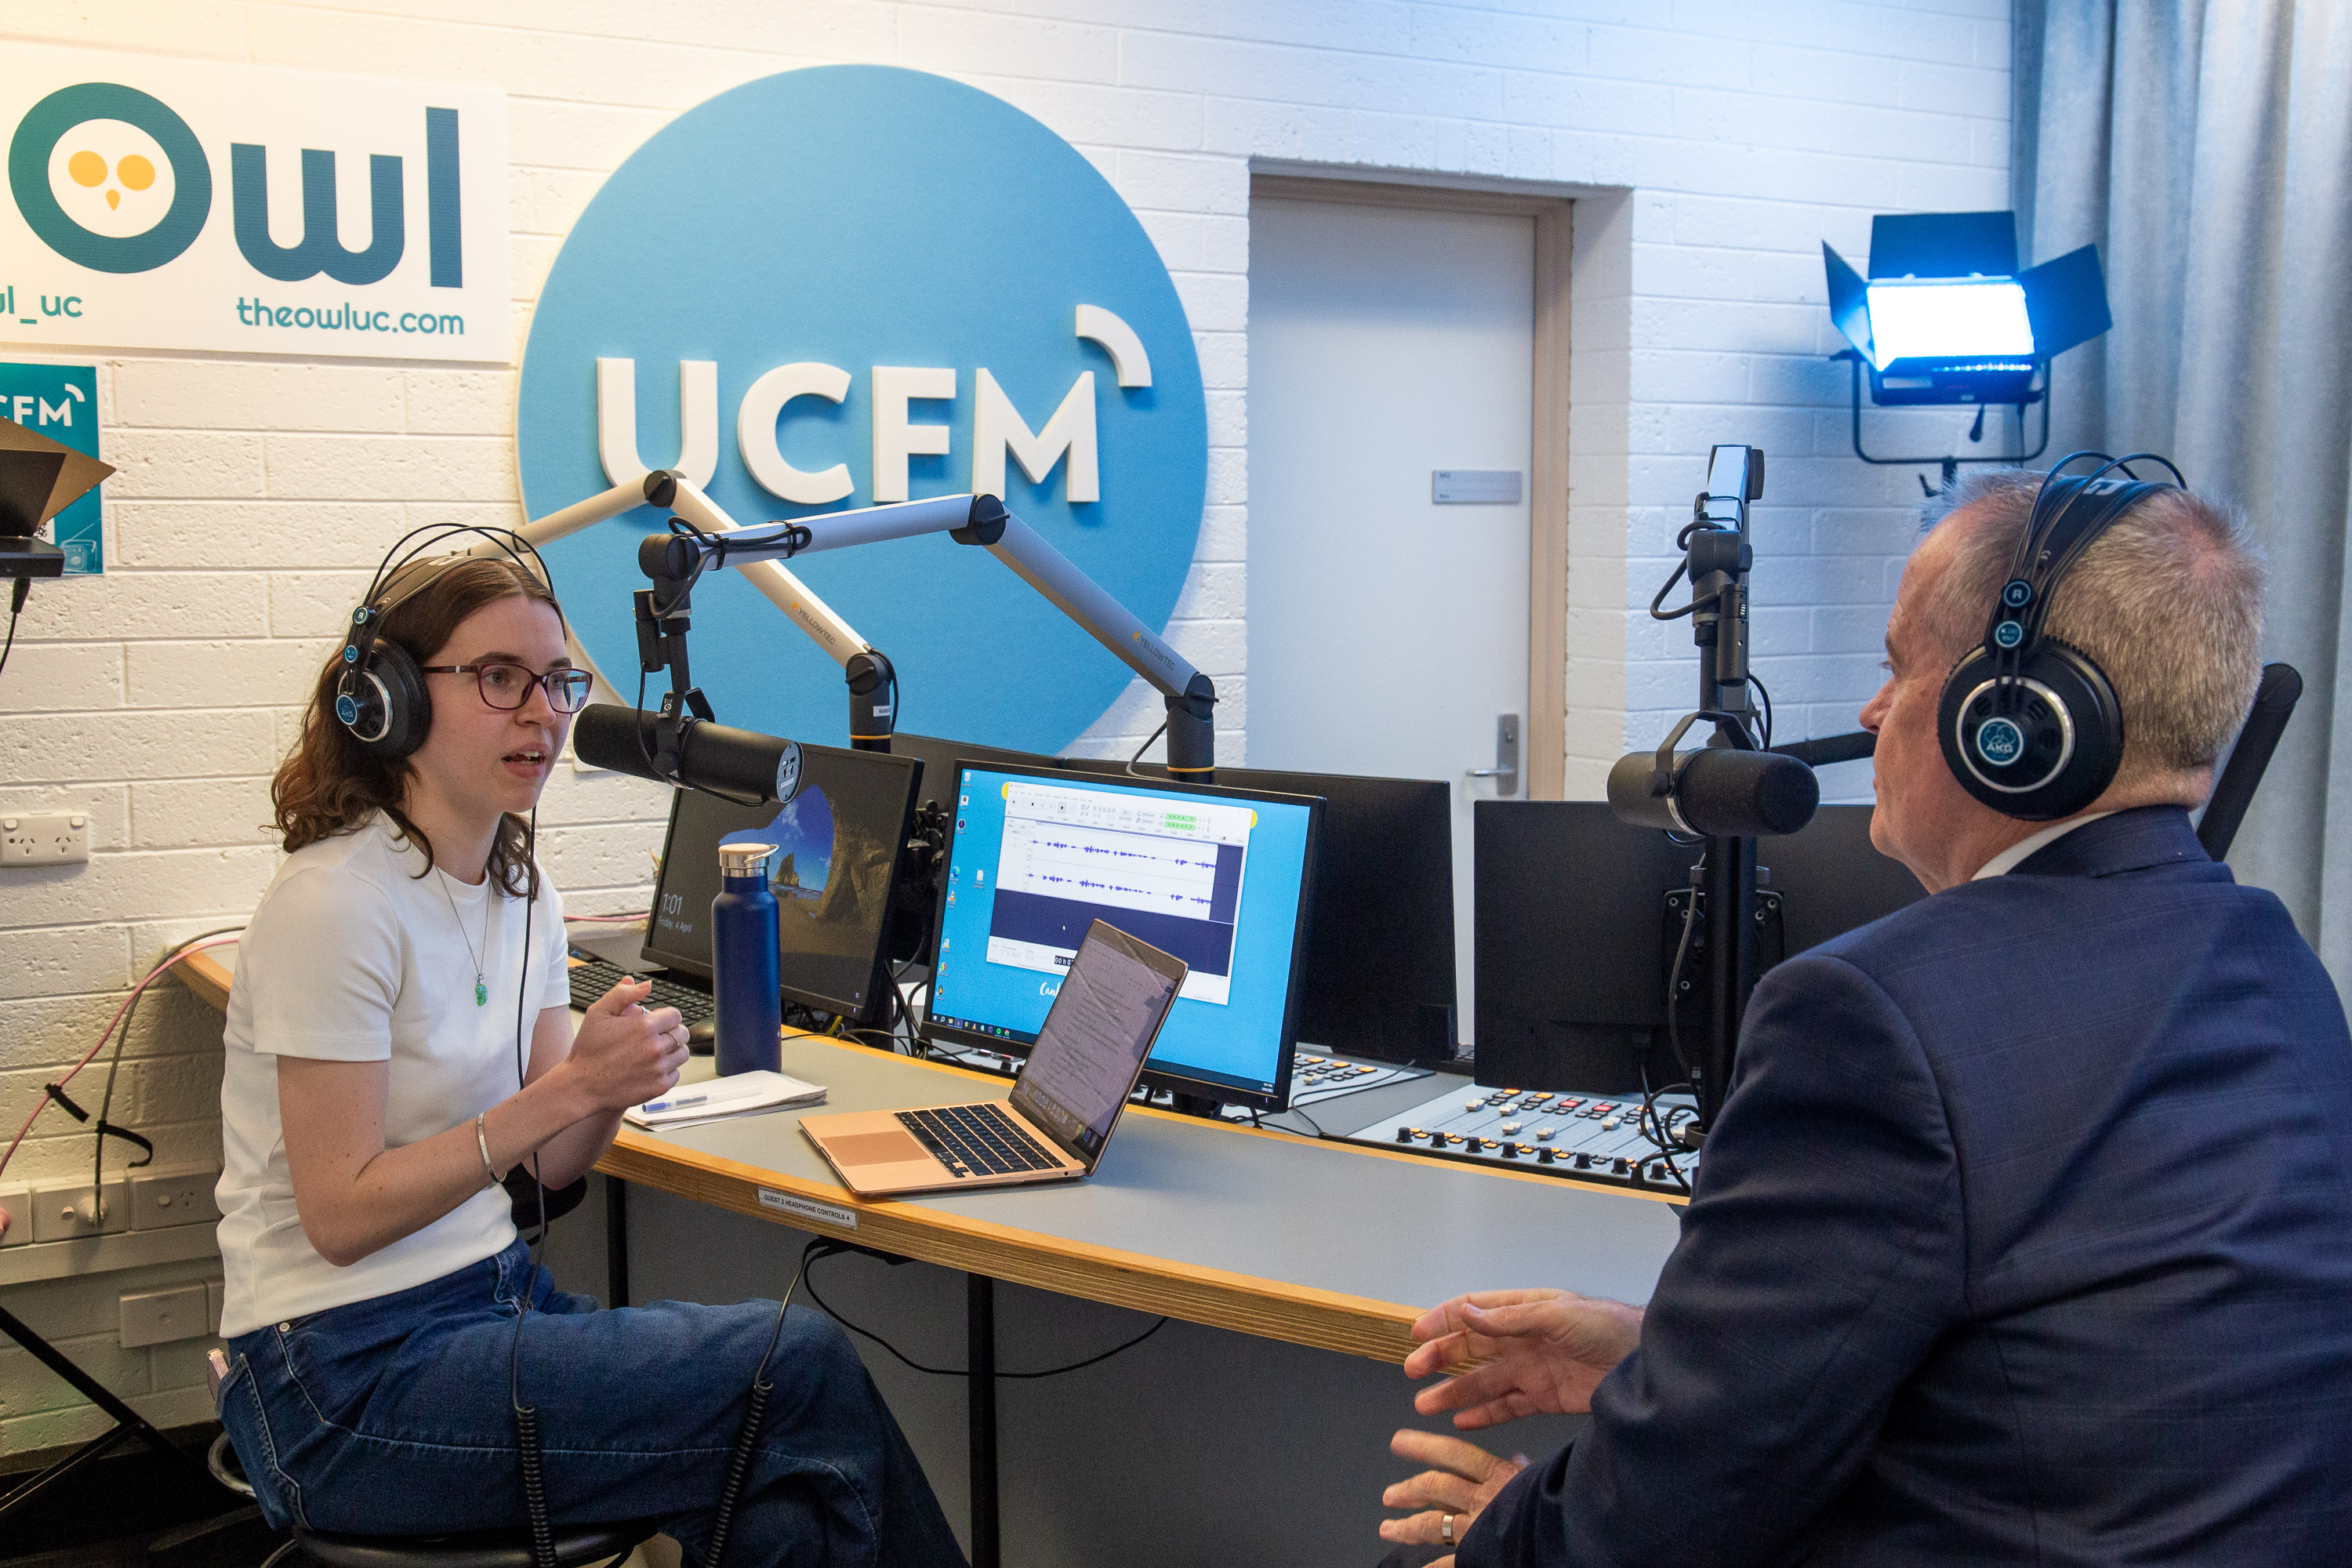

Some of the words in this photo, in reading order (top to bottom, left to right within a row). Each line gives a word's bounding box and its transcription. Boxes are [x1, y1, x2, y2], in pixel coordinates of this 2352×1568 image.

[8, 82, 463, 289] Owl
[0, 285, 83, 325] l_uc
[236, 297, 465, 335] theowluc.com
[597, 358, 1100, 504] UCFM
[2013, 589, 2022, 599] R
[798, 608, 837, 645] YELLOWTEC
[1140, 636, 1176, 671] YELLOWTEC
[1986, 742, 2013, 753] AKG
[662, 893, 683, 916] 1:01
[679, 921, 692, 933] April
[764, 1193, 780, 1205] GUEST
[785, 1200, 816, 1213] HEADPHONE
[817, 1207, 845, 1220] CONTROLS
